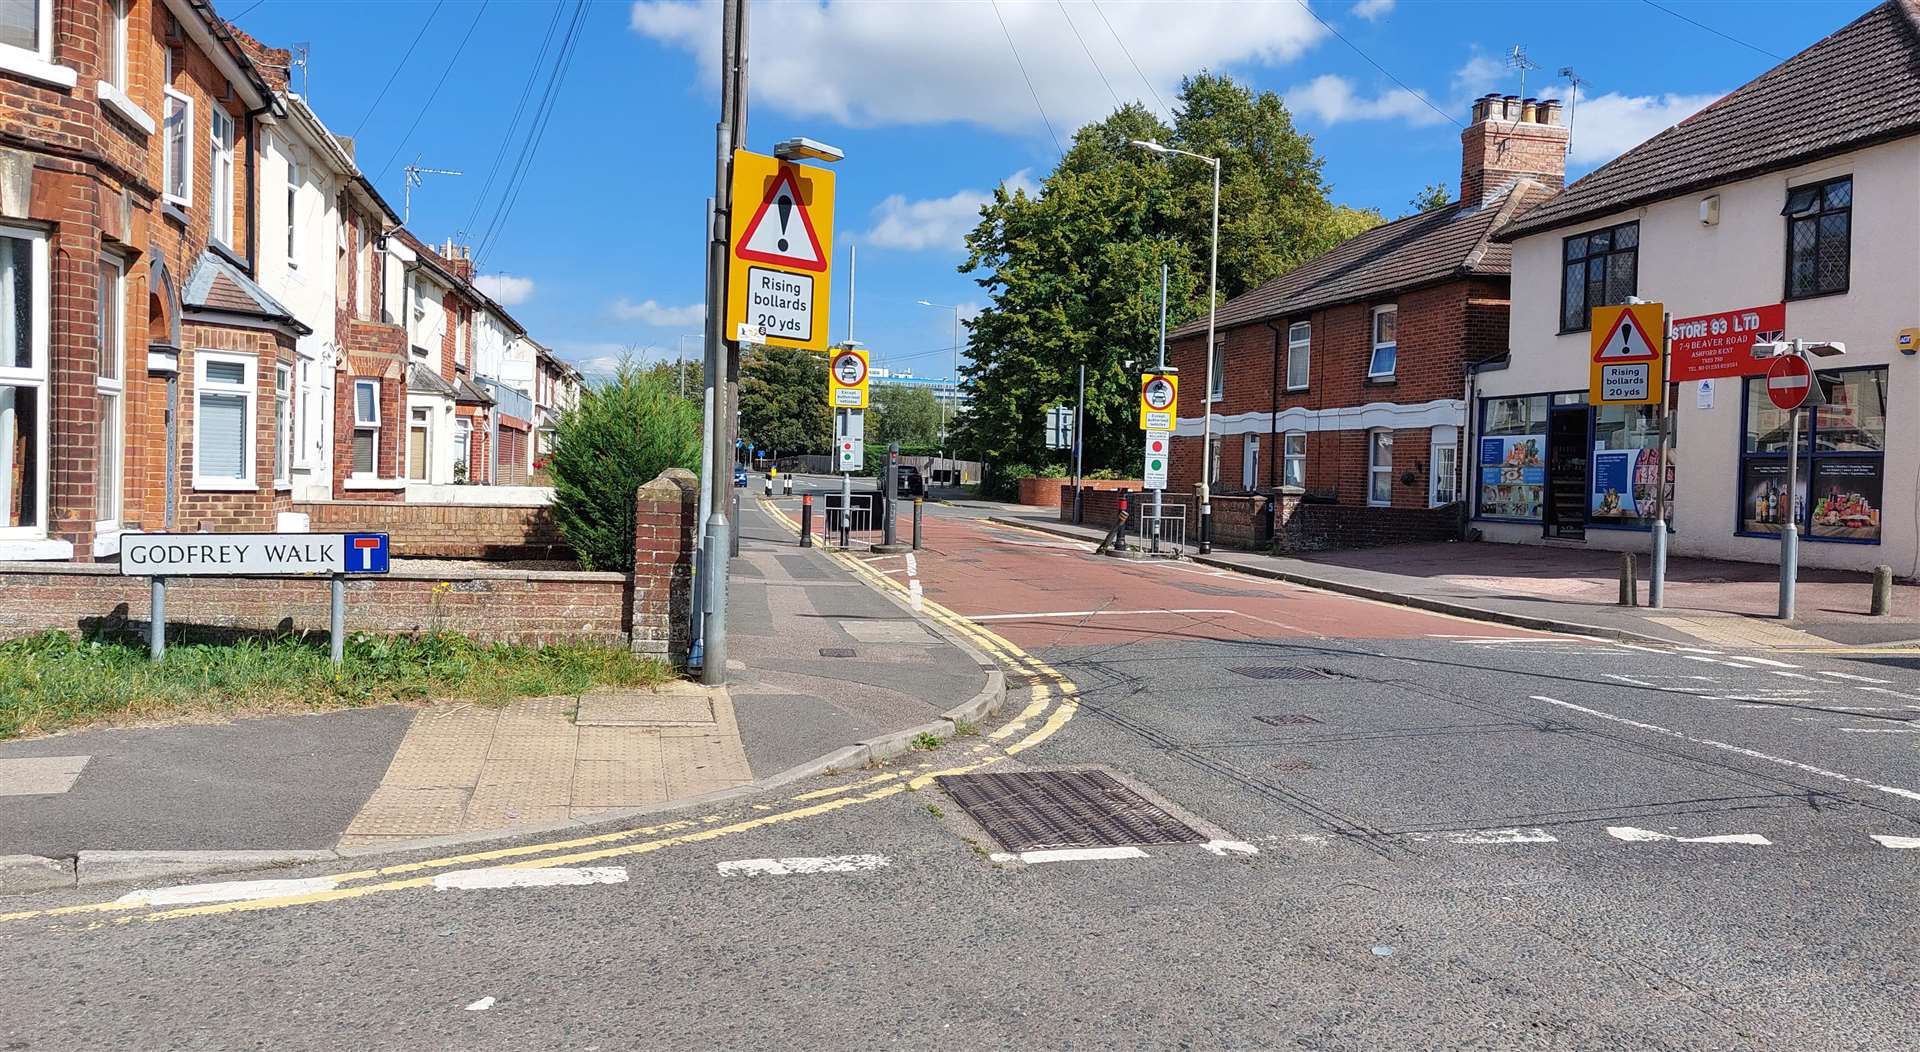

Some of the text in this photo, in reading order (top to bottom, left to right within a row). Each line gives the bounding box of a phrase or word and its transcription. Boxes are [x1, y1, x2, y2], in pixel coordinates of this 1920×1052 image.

[761, 276, 801, 296] Rising
[754, 292, 807, 311] bollards
[757, 313, 801, 332] 20 yds
[1671, 312, 1760, 340] STORE 93 LTD
[1679, 335, 1748, 351] 7-9 BEAVER ROAD
[1691, 349, 1717, 357] ASHFORD
[1606, 376, 1644, 385] bollards
[1611, 367, 1640, 377] Rising
[1609, 388, 1640, 397] 20 yds
[130, 544, 335, 564] GODFREY WALK
